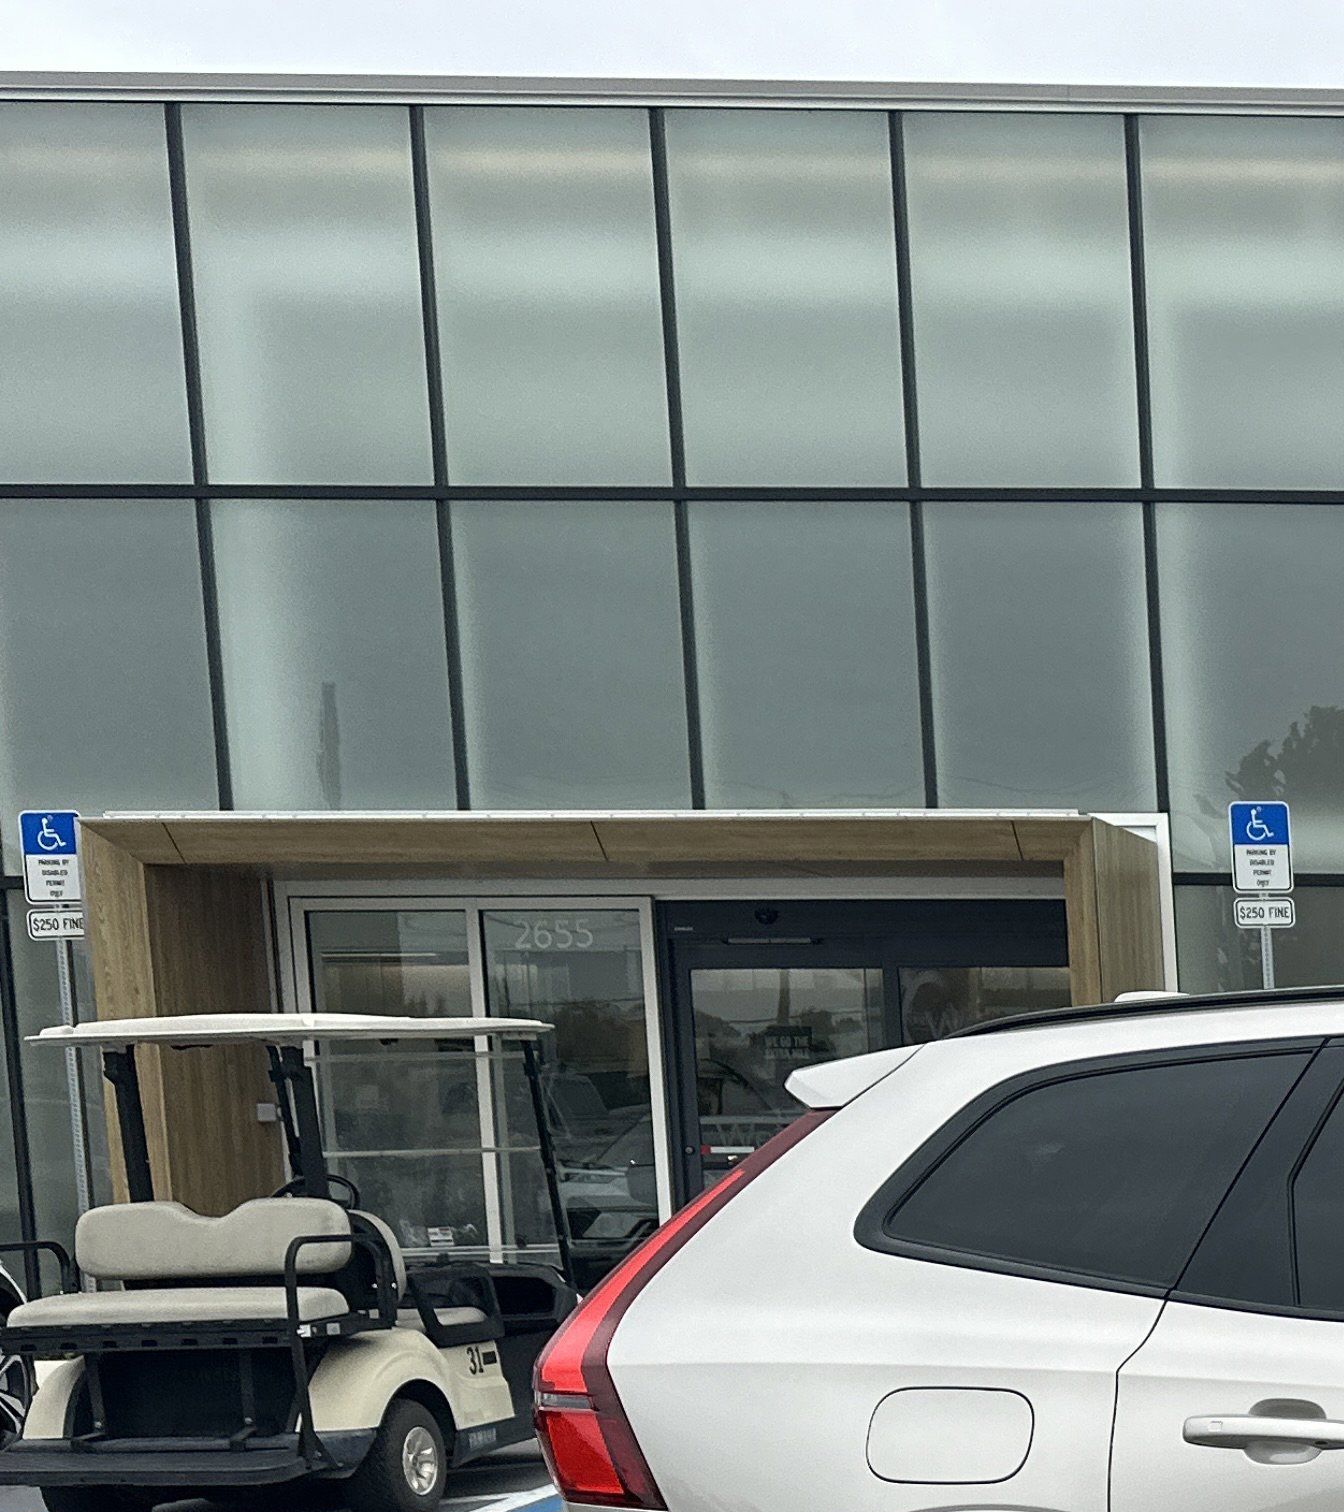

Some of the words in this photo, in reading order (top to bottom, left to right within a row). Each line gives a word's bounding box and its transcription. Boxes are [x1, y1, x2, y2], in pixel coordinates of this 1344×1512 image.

[33, 917, 60, 932] $250
[62, 917, 85, 930] FINE
[1239, 906, 1265, 920] $250
[1268, 907, 1290, 919] FINE
[514, 918, 594, 949] 2655
[466, 1345, 484, 1376] 31
